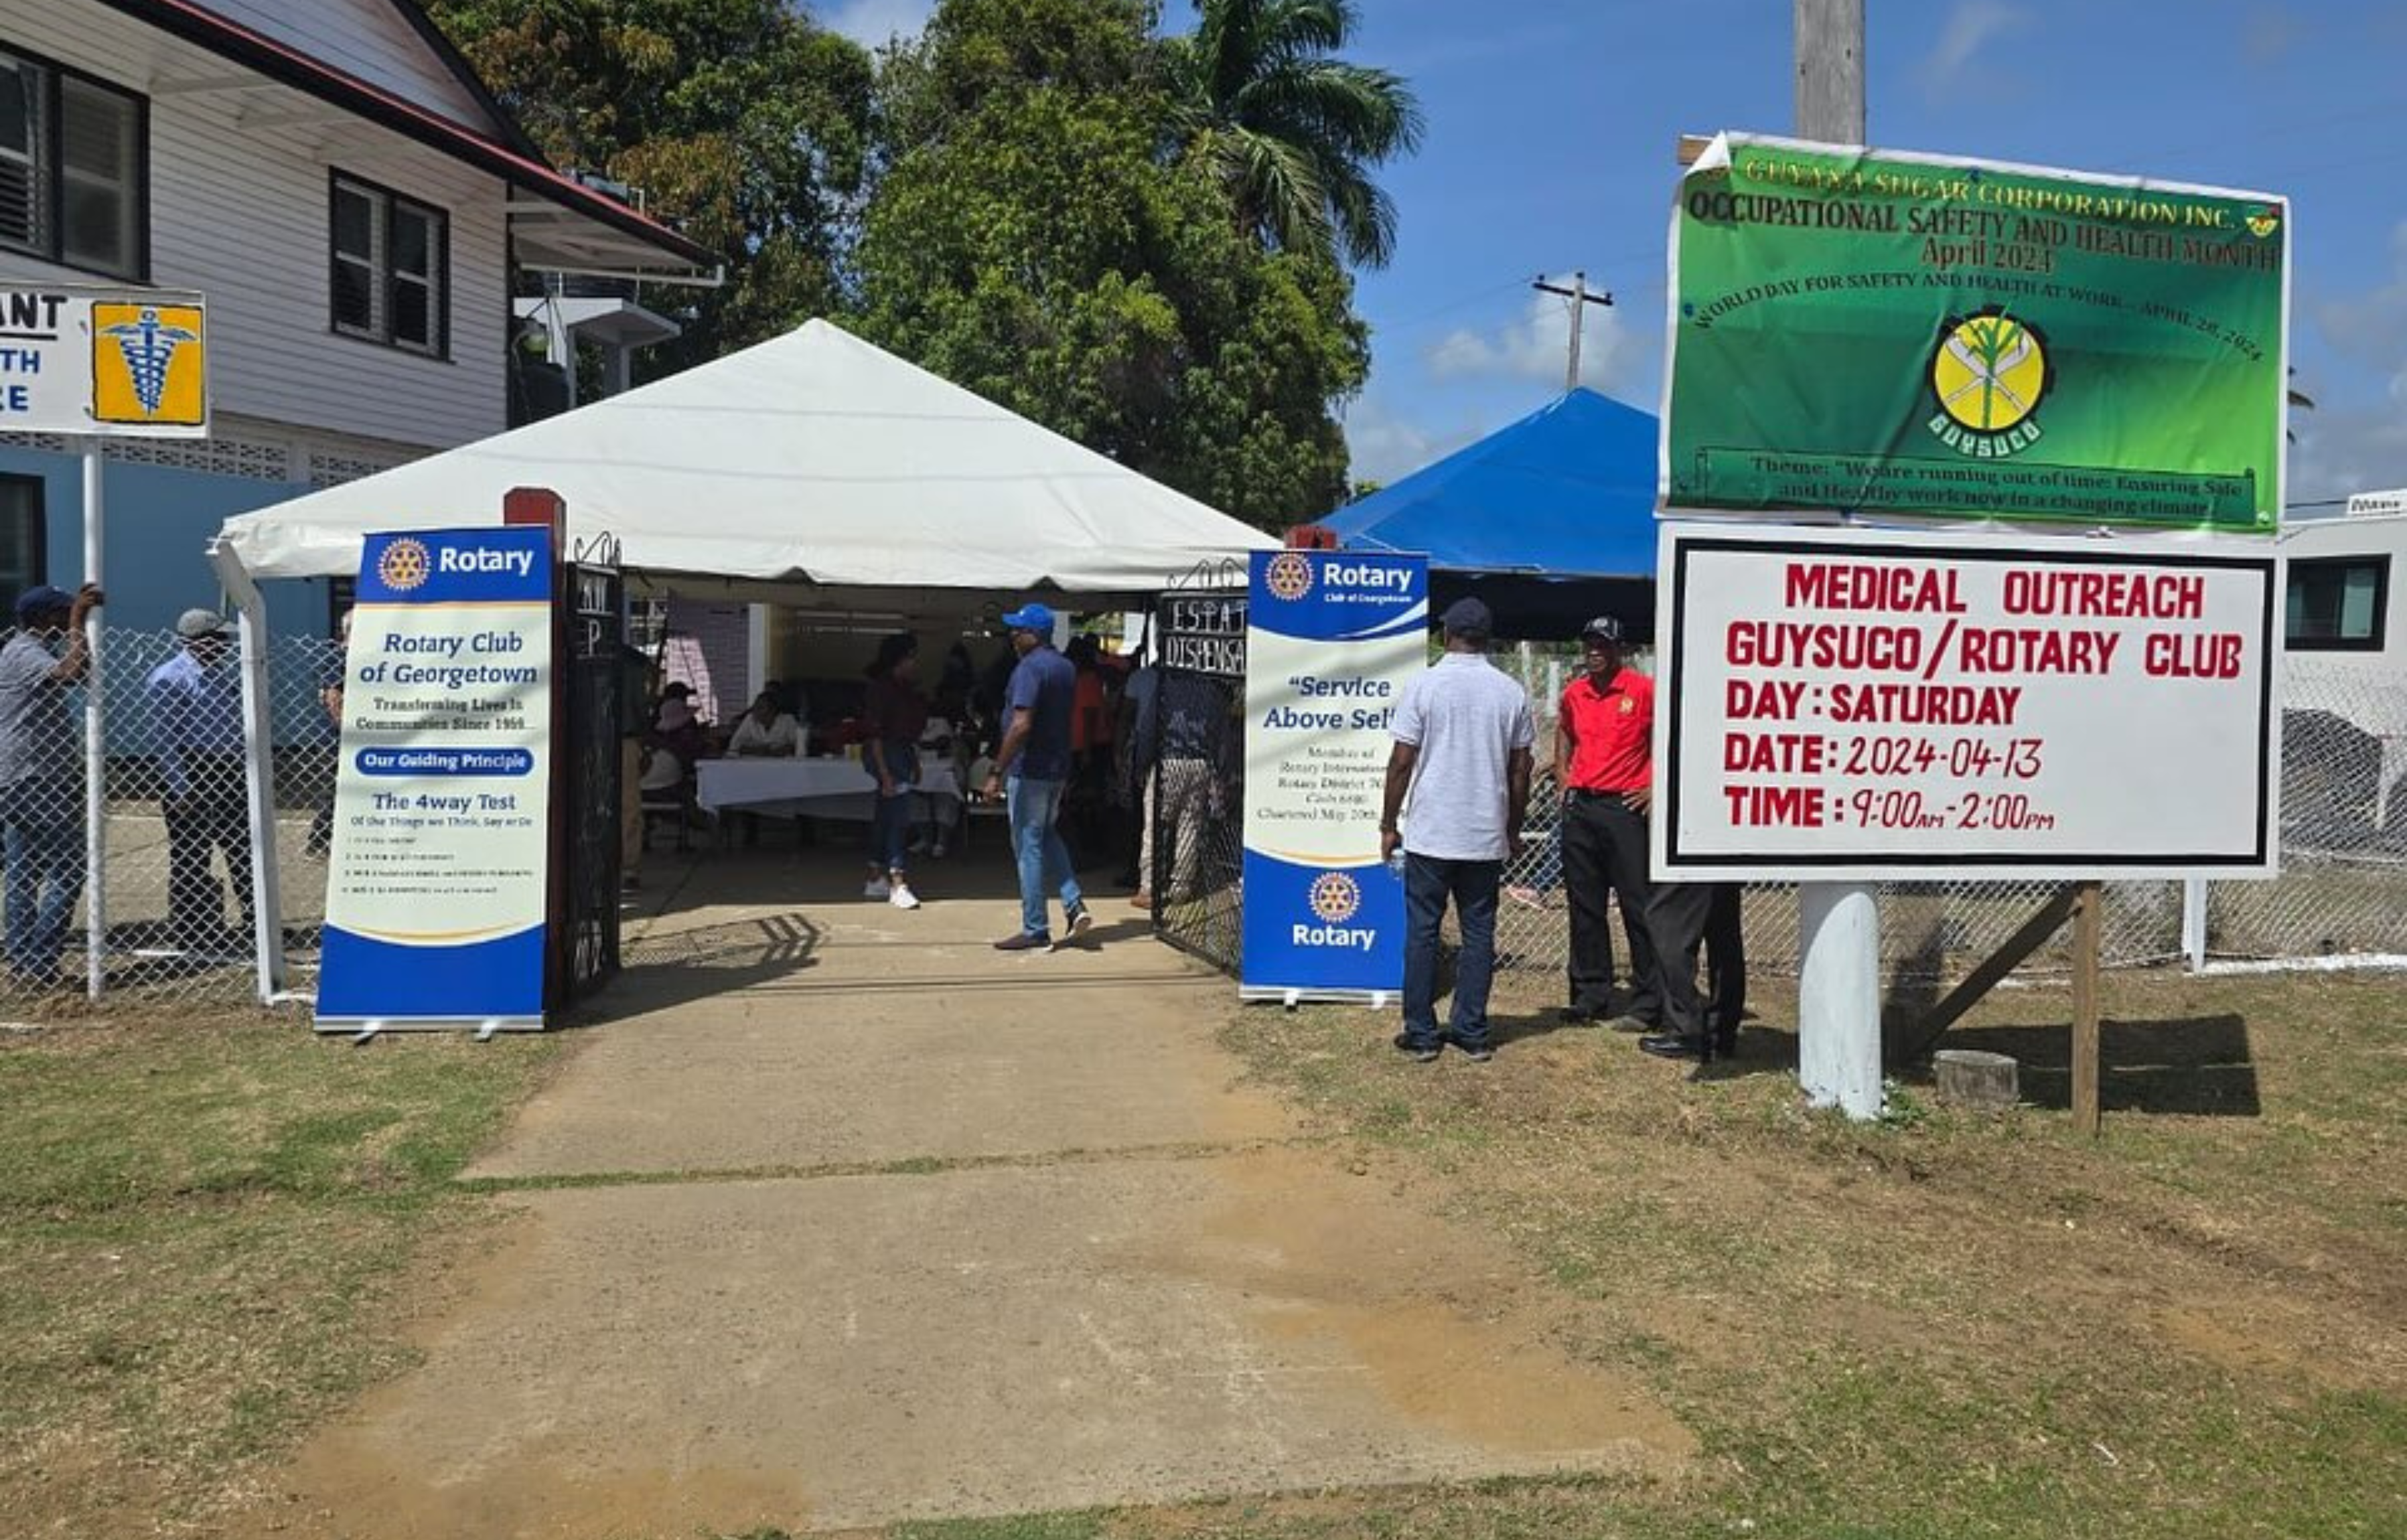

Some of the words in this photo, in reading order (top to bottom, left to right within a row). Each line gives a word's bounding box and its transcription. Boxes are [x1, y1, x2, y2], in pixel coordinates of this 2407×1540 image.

[1747, 161, 1864, 189] GUYANA
[1875, 173, 1969, 200] SUGAR
[1978, 184, 2178, 224] CORPORATION
[2185, 205, 2236, 230] INC.
[1689, 191, 1899, 232] OCCUPATIONAL
[1908, 206, 2009, 237] SAFETY
[2015, 217, 2068, 246] AND
[2075, 222, 2173, 261] HEALTH
[2183, 238, 2277, 272] MONTH
[1922, 238, 1985, 271] April
[1994, 243, 2055, 275] 2024
[0, 293, 68, 329] NT
[1694, 287, 1762, 330] WORLD
[1764, 279, 1800, 302] DAY
[1804, 274, 1844, 292] FOR
[1847, 272, 1917, 289] SAFETY
[1923, 273, 1962, 288] AND
[1968, 275, 2037, 296] HEALTH
[2040, 283, 2063, 299] AT
[0, 384, 29, 412] E
[2002, 471, 2036, 484] out
[2039, 470, 2062, 485] of
[439, 546, 534, 577] Rotary
[1324, 563, 1412, 592] Rotary
[1785, 563, 1967, 613] MEDICAL
[2003, 570, 2204, 619] OUTREACH
[383, 633, 463, 659] Rotary
[470, 631, 523, 653] Club
[1726, 618, 2121, 680] GUYSUCO/ROTARY
[2145, 633, 2243, 679] CLUB
[359, 661, 389, 683] of
[392, 663, 538, 690] Georgetown
[1263, 706, 1343, 730] Above
[364, 753, 395, 768] Our
[398, 753, 458, 771] Guiding
[461, 753, 527, 772] Principle
[372, 792, 410, 811] The
[415, 793, 472, 814] 4way
[478, 793, 516, 811] Test
[1292, 924, 1376, 951] Rotary
